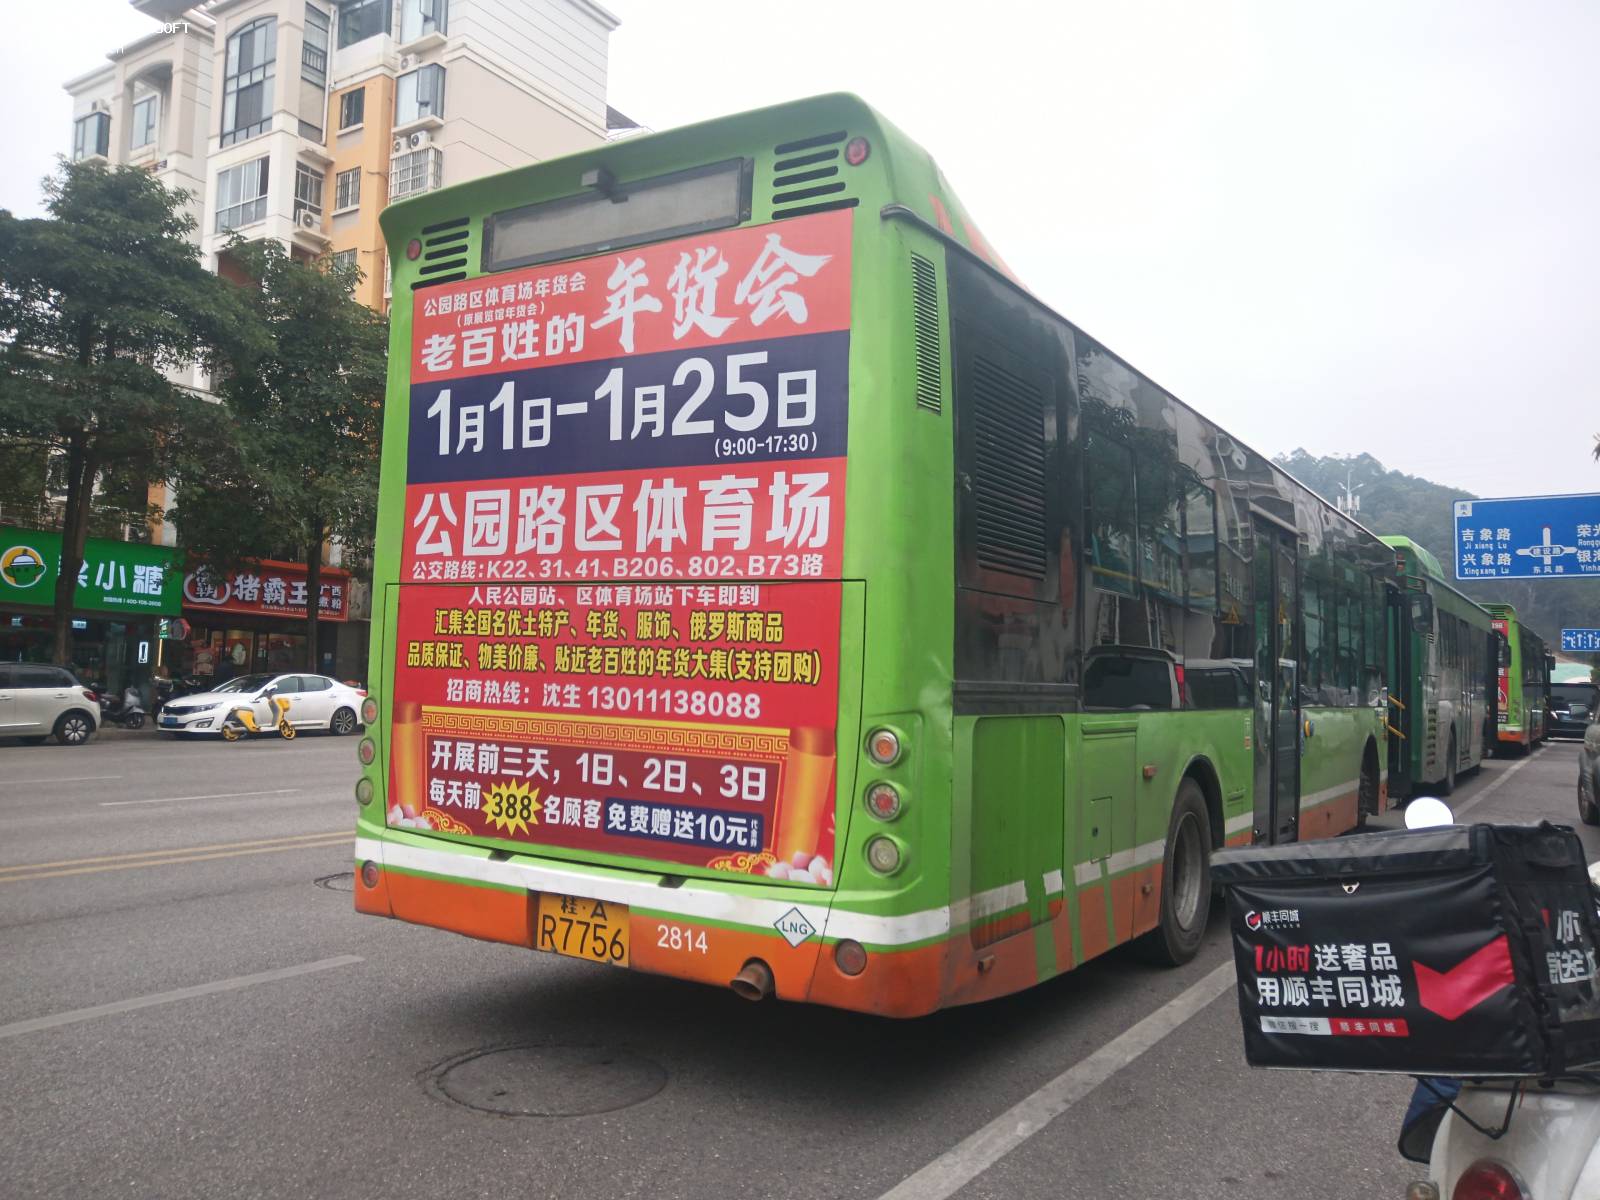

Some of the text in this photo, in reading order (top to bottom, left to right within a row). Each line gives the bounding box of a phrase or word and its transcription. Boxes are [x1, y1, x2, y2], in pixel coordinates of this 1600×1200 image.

[423, 272, 587, 318] 公园路区体育场年货会
[590, 232, 834, 354] 年货会
[421, 312, 586, 373] 老百姓的
[713, 431, 818, 458] (9:00-17:30)
[412, 471, 831, 558] 公园路区体育场
[1461, 527, 1511, 542] 吉象路
[1462, 553, 1512, 567] 兴象路
[232, 573, 309, 607] 猪霸王
[429, 778, 750, 847] 每天前 388 名顾客 免费赠送10元
[540, 914, 626, 961] R7756
[656, 924, 709, 955] 2814
[781, 920, 809, 937] LNG
[1256, 975, 1406, 1009] 用顺丰同城
